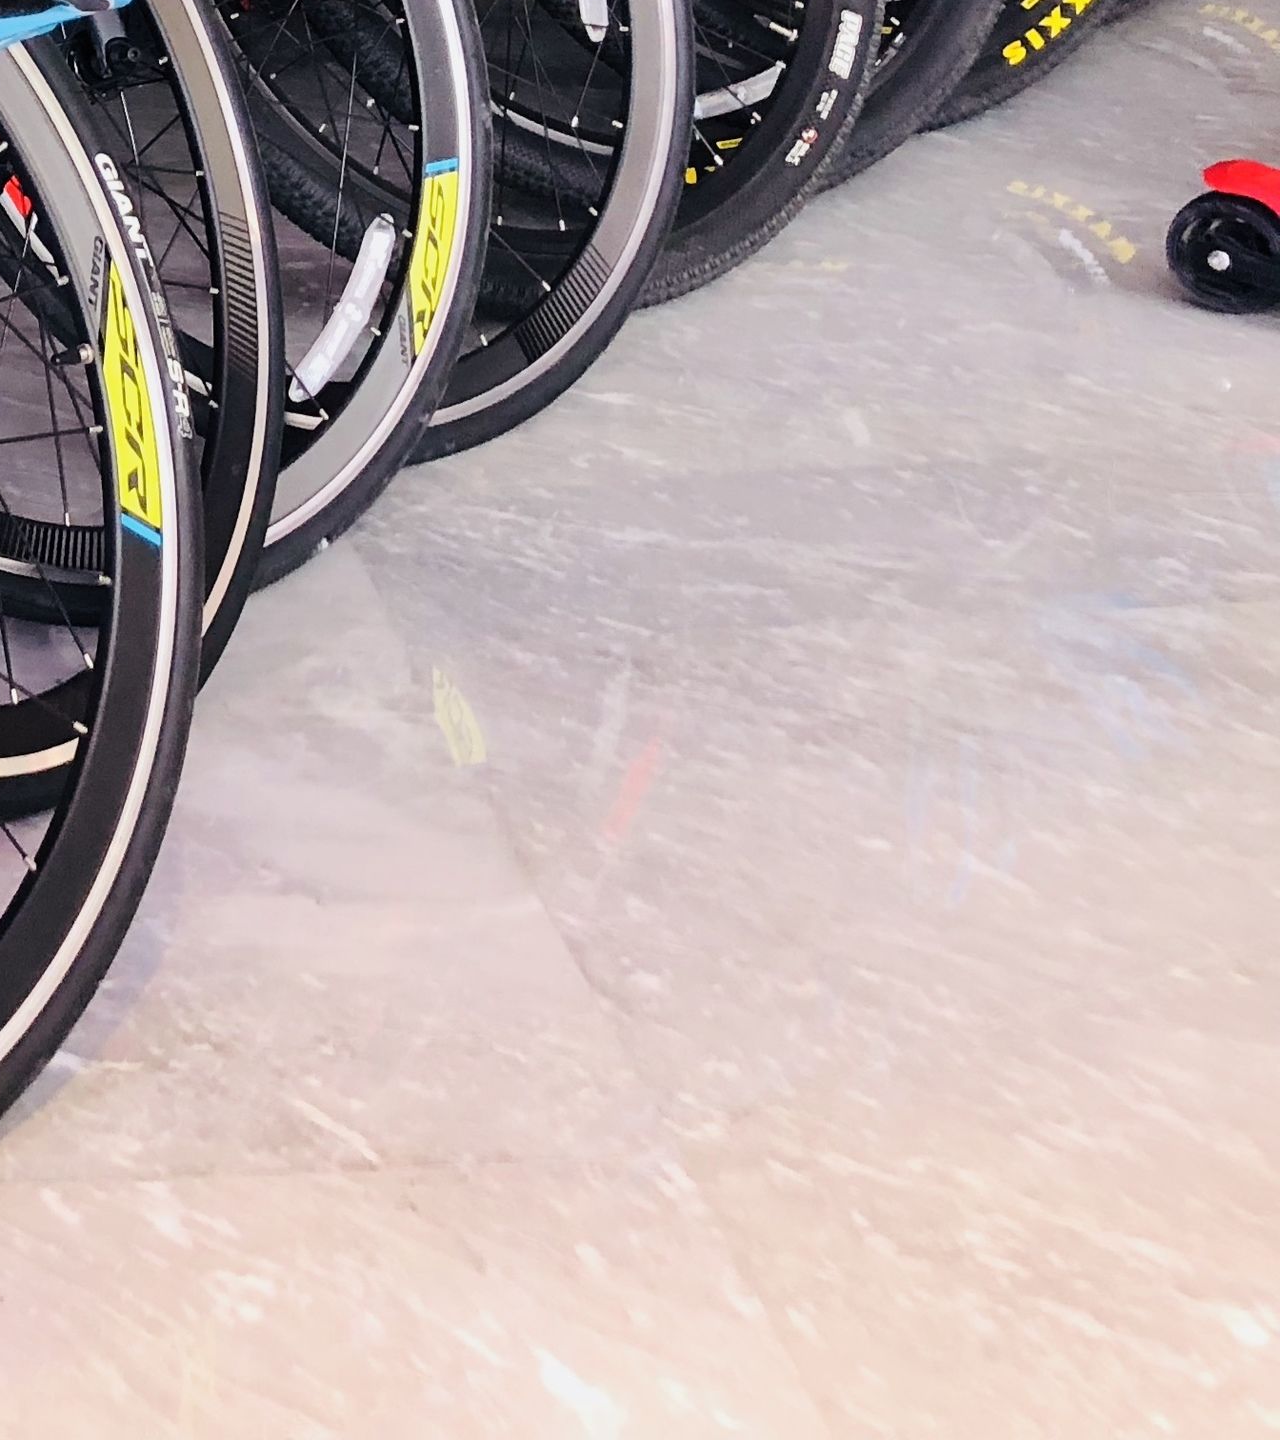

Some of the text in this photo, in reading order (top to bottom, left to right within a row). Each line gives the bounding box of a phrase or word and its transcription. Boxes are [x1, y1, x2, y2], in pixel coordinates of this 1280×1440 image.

[94, 152, 154, 268] GIANT
[86, 235, 106, 315] GIANT
[109, 275, 149, 515] SCR
